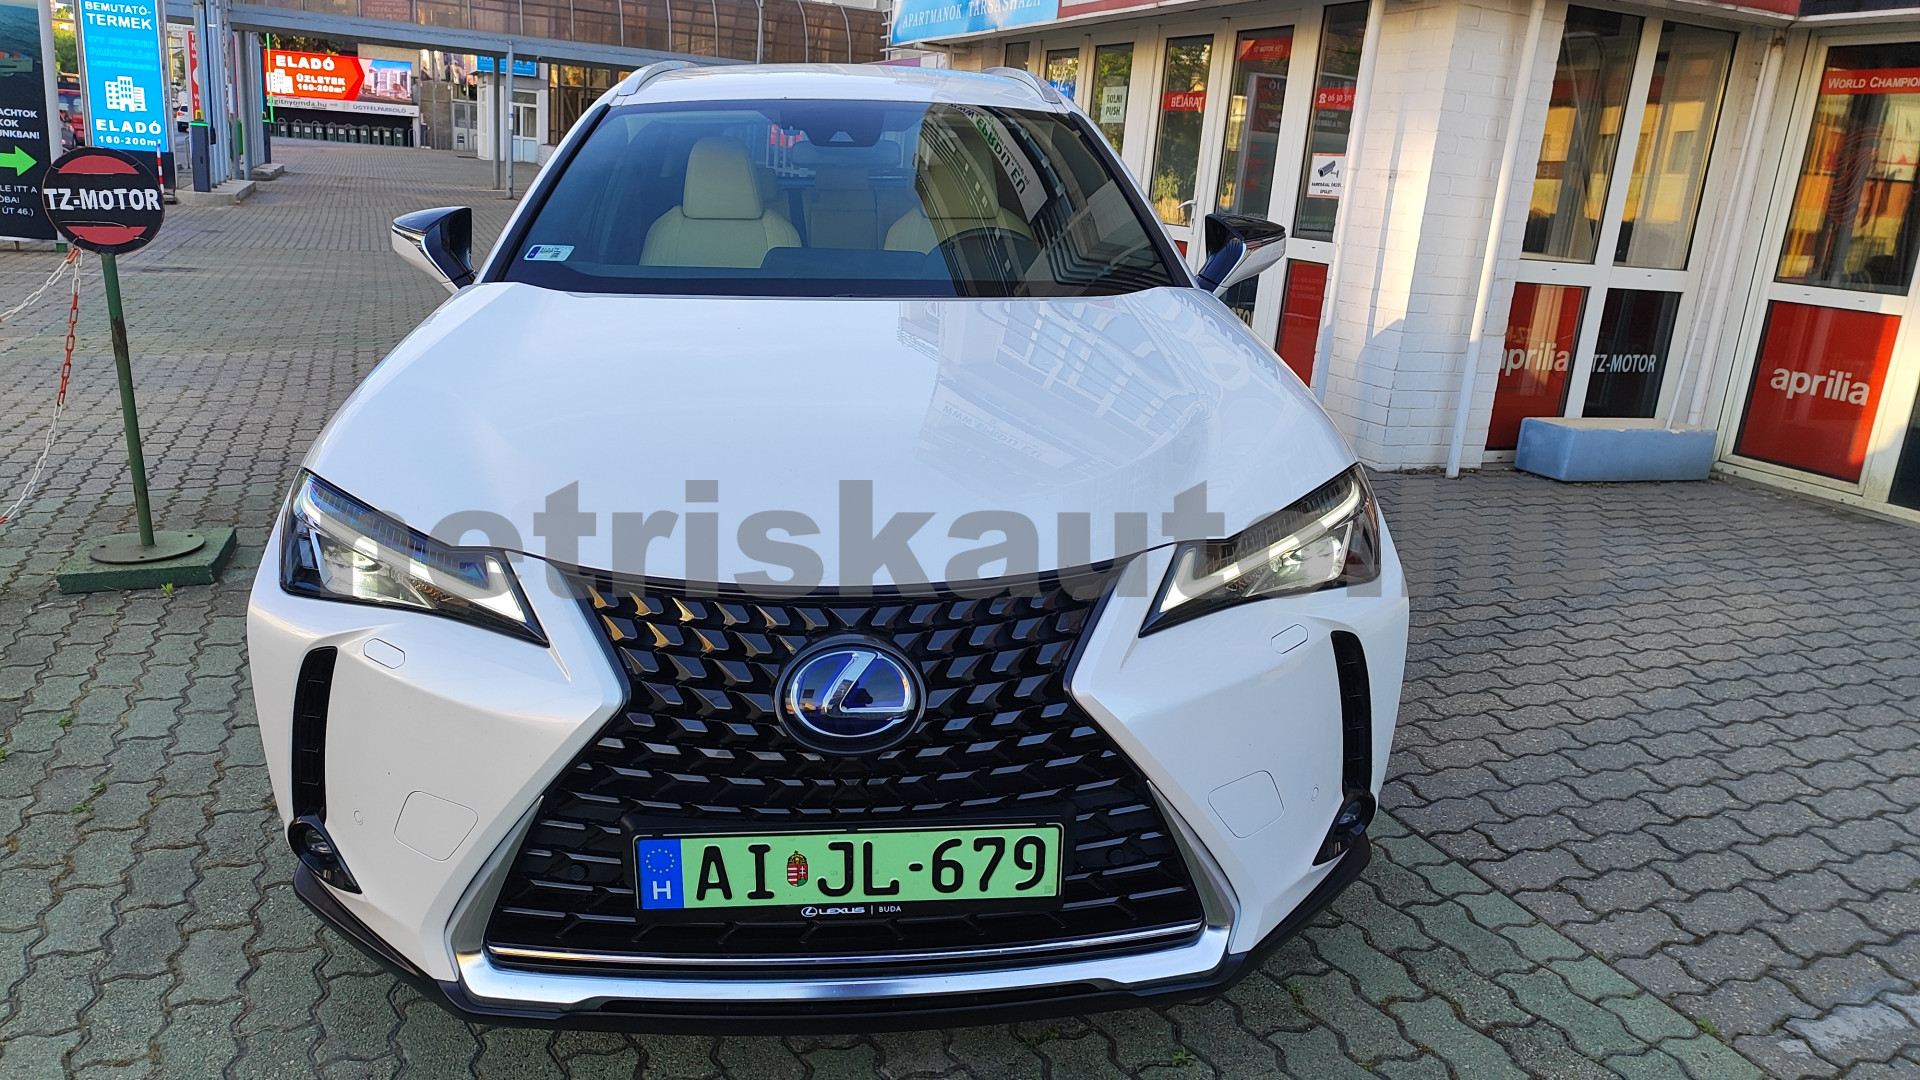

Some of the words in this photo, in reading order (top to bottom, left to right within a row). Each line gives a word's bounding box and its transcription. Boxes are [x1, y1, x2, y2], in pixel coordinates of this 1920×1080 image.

[85, 1, 151, 15] BEMUTATÓ-
[86, 13, 152, 30] TERMEK
[902, 4, 962, 28] APARTMANOK
[275, 55, 335, 70] ELADÓ
[1828, 78, 1866, 89] WORLD
[268, 99, 328, 108] gitnyomda.hu
[1171, 94, 1204, 108] BEJÁRAT
[1105, 106, 1121, 116] PUSH
[95, 119, 162, 135] ELADÓ
[13, 185, 29, 193] ITT
[31, 186, 38, 194] A
[43, 188, 161, 211] TZ-MOTOR
[1, 205, 15, 215] ÚT
[17, 208, 34, 217] 46.)
[1592, 354, 1657, 373] TZ-MOTOR
[1770, 368, 1870, 406] aprilia
[652, 880, 672, 900] H
[819, 906, 866, 915] LEXUS
[878, 905, 902, 913] BUDA
